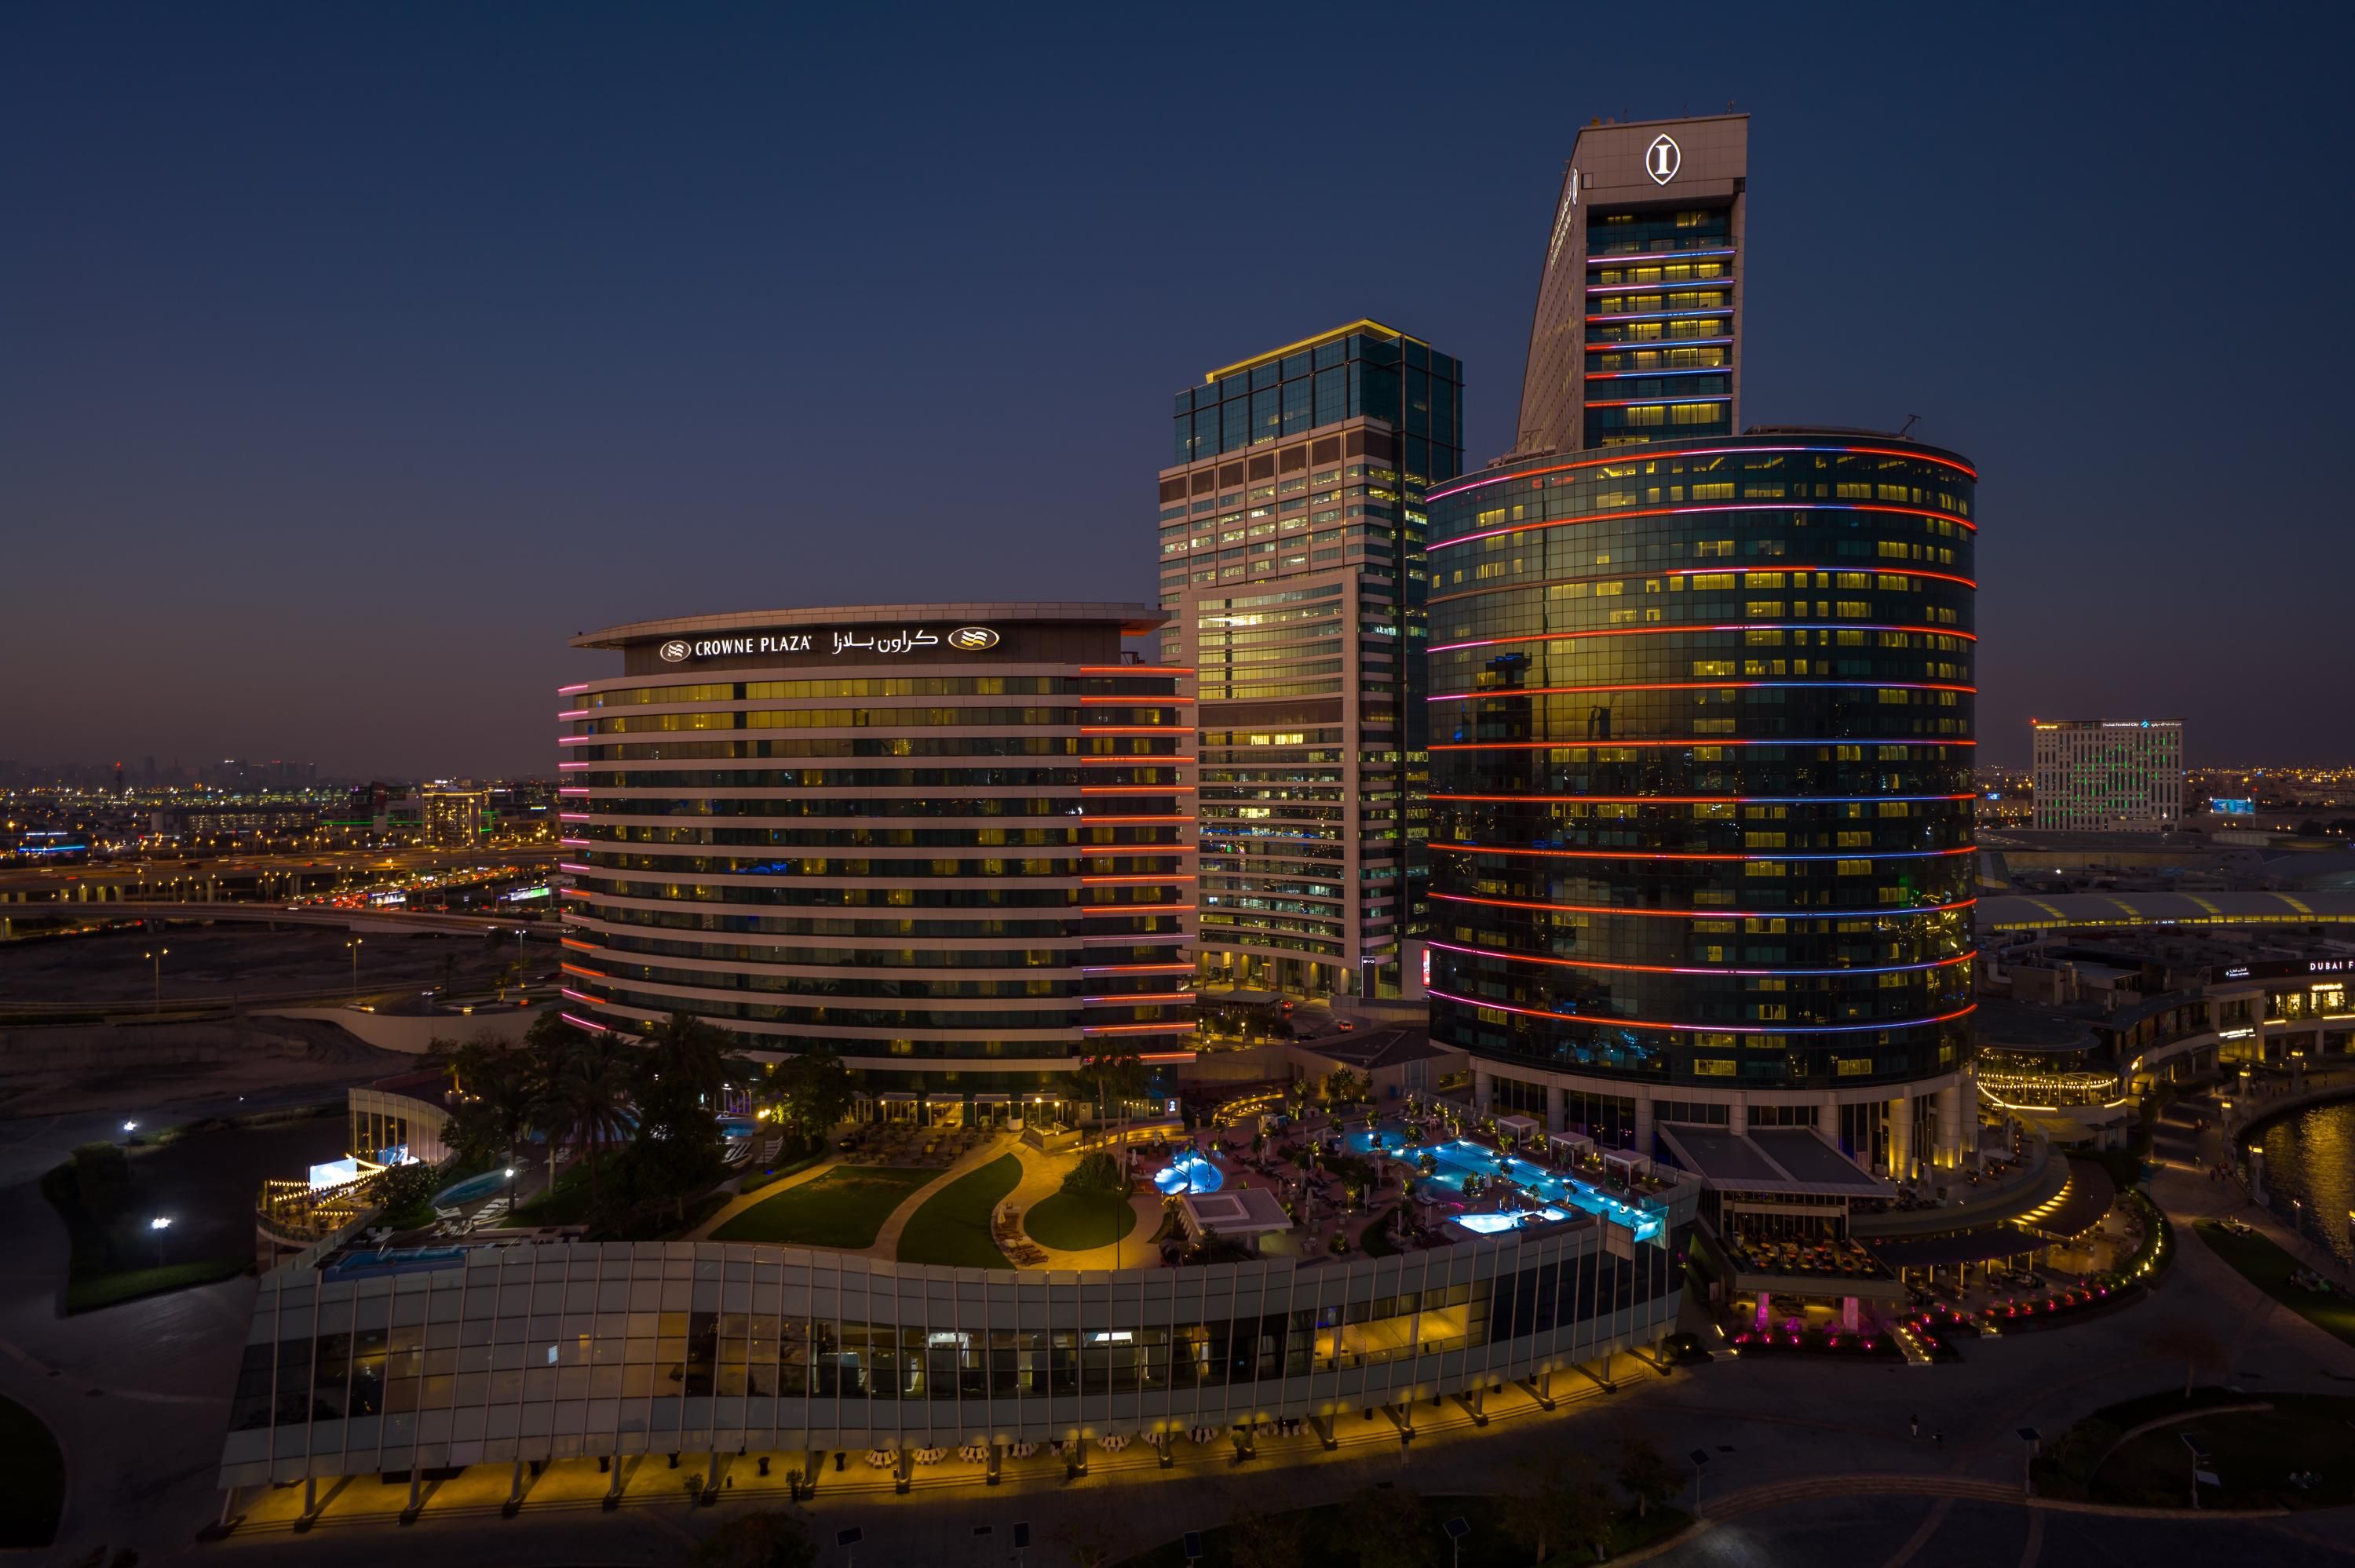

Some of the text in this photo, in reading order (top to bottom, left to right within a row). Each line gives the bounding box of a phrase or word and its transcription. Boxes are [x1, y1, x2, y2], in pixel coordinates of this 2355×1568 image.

[696, 634, 811, 657] CROWNE PLAZA
[831, 629, 939, 655] كراون بلازا
[2310, 961, 2342, 971] DUBAI
